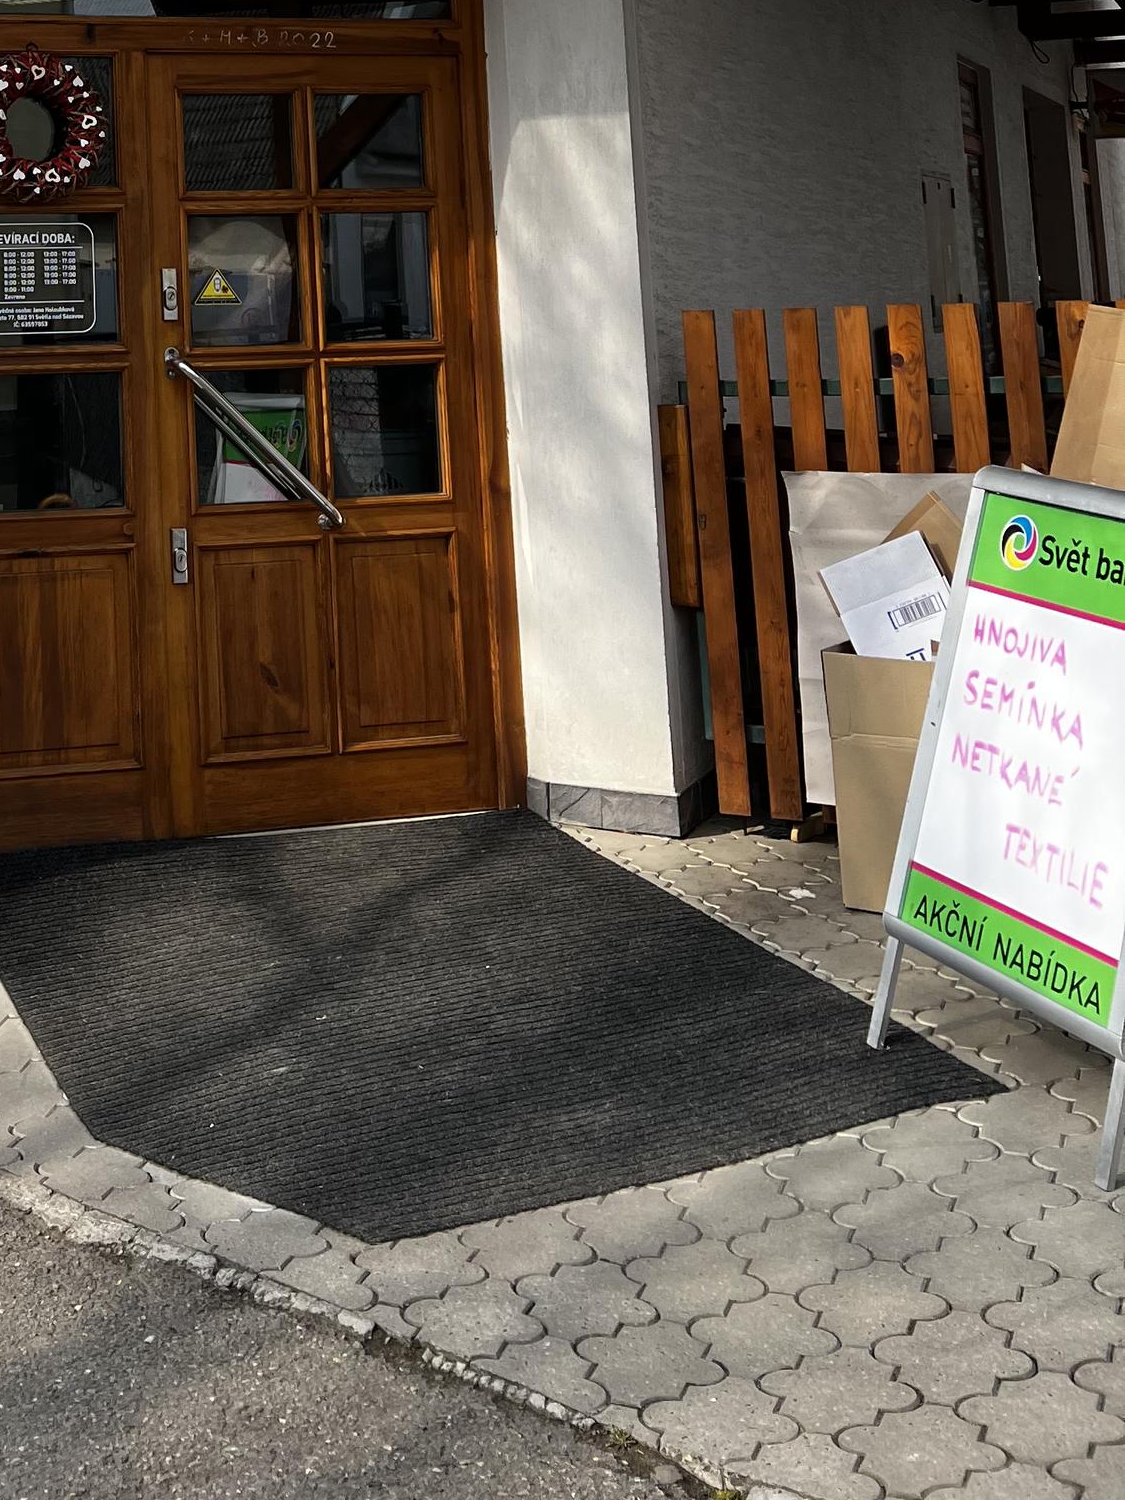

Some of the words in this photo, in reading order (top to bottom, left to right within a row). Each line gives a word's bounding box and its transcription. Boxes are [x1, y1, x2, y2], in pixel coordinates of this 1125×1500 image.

[41, 233, 76, 244] DOBA:
[1039, 535, 1090, 576] Svět
[1096, 548, 1125, 586] ba
[974, 613, 1067, 675] HNOJIVA
[1002, 822, 1110, 909] TEXTILIE
[913, 895, 988, 951] AKČNÍ
[993, 933, 1101, 1015] NABÍDKA
